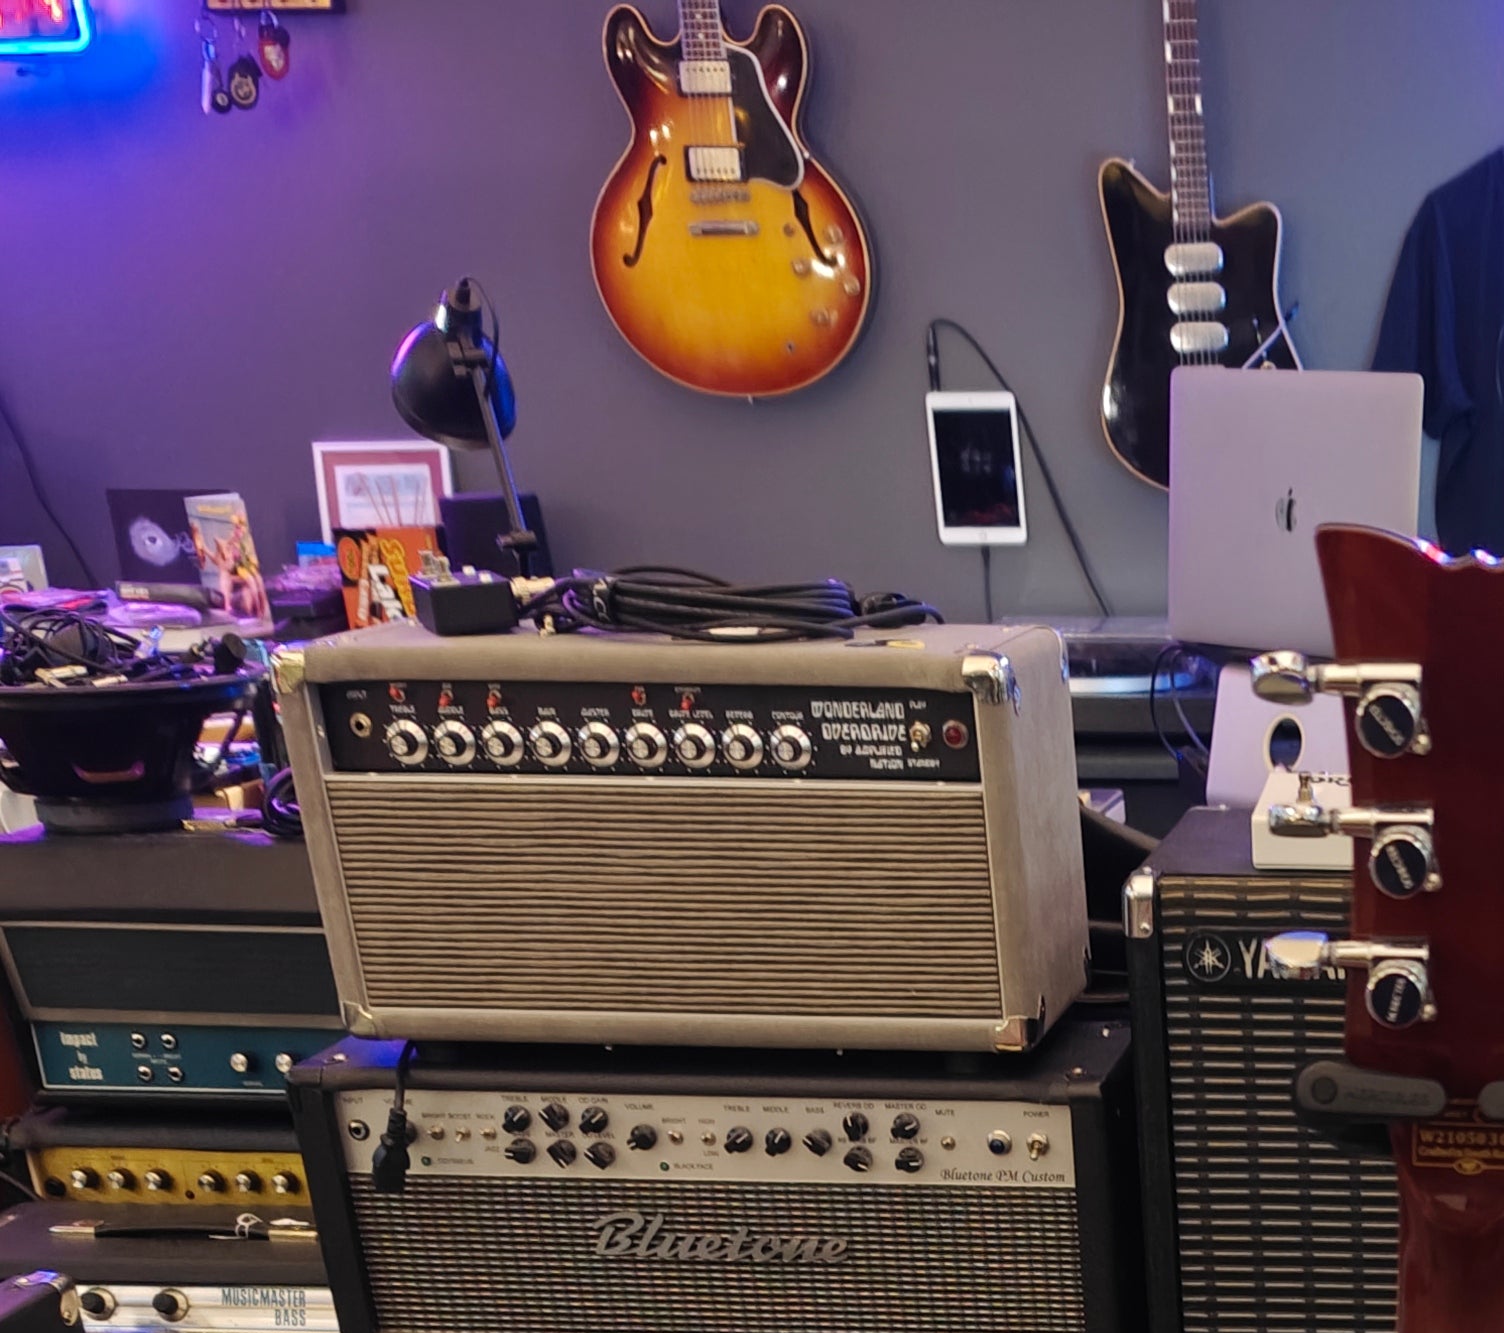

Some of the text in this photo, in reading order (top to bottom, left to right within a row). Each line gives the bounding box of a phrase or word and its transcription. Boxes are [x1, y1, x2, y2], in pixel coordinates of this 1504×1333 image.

[811, 701, 905, 719] WONDERLAND
[822, 723, 907, 741] OVERDRIVE
[941, 1168, 1066, 1183] Bluetone PM Custom
[593, 1211, 848, 1262] Bluetone
[221, 1288, 306, 1308] MUSICMASTER
[275, 1309, 306, 1327] BASS
